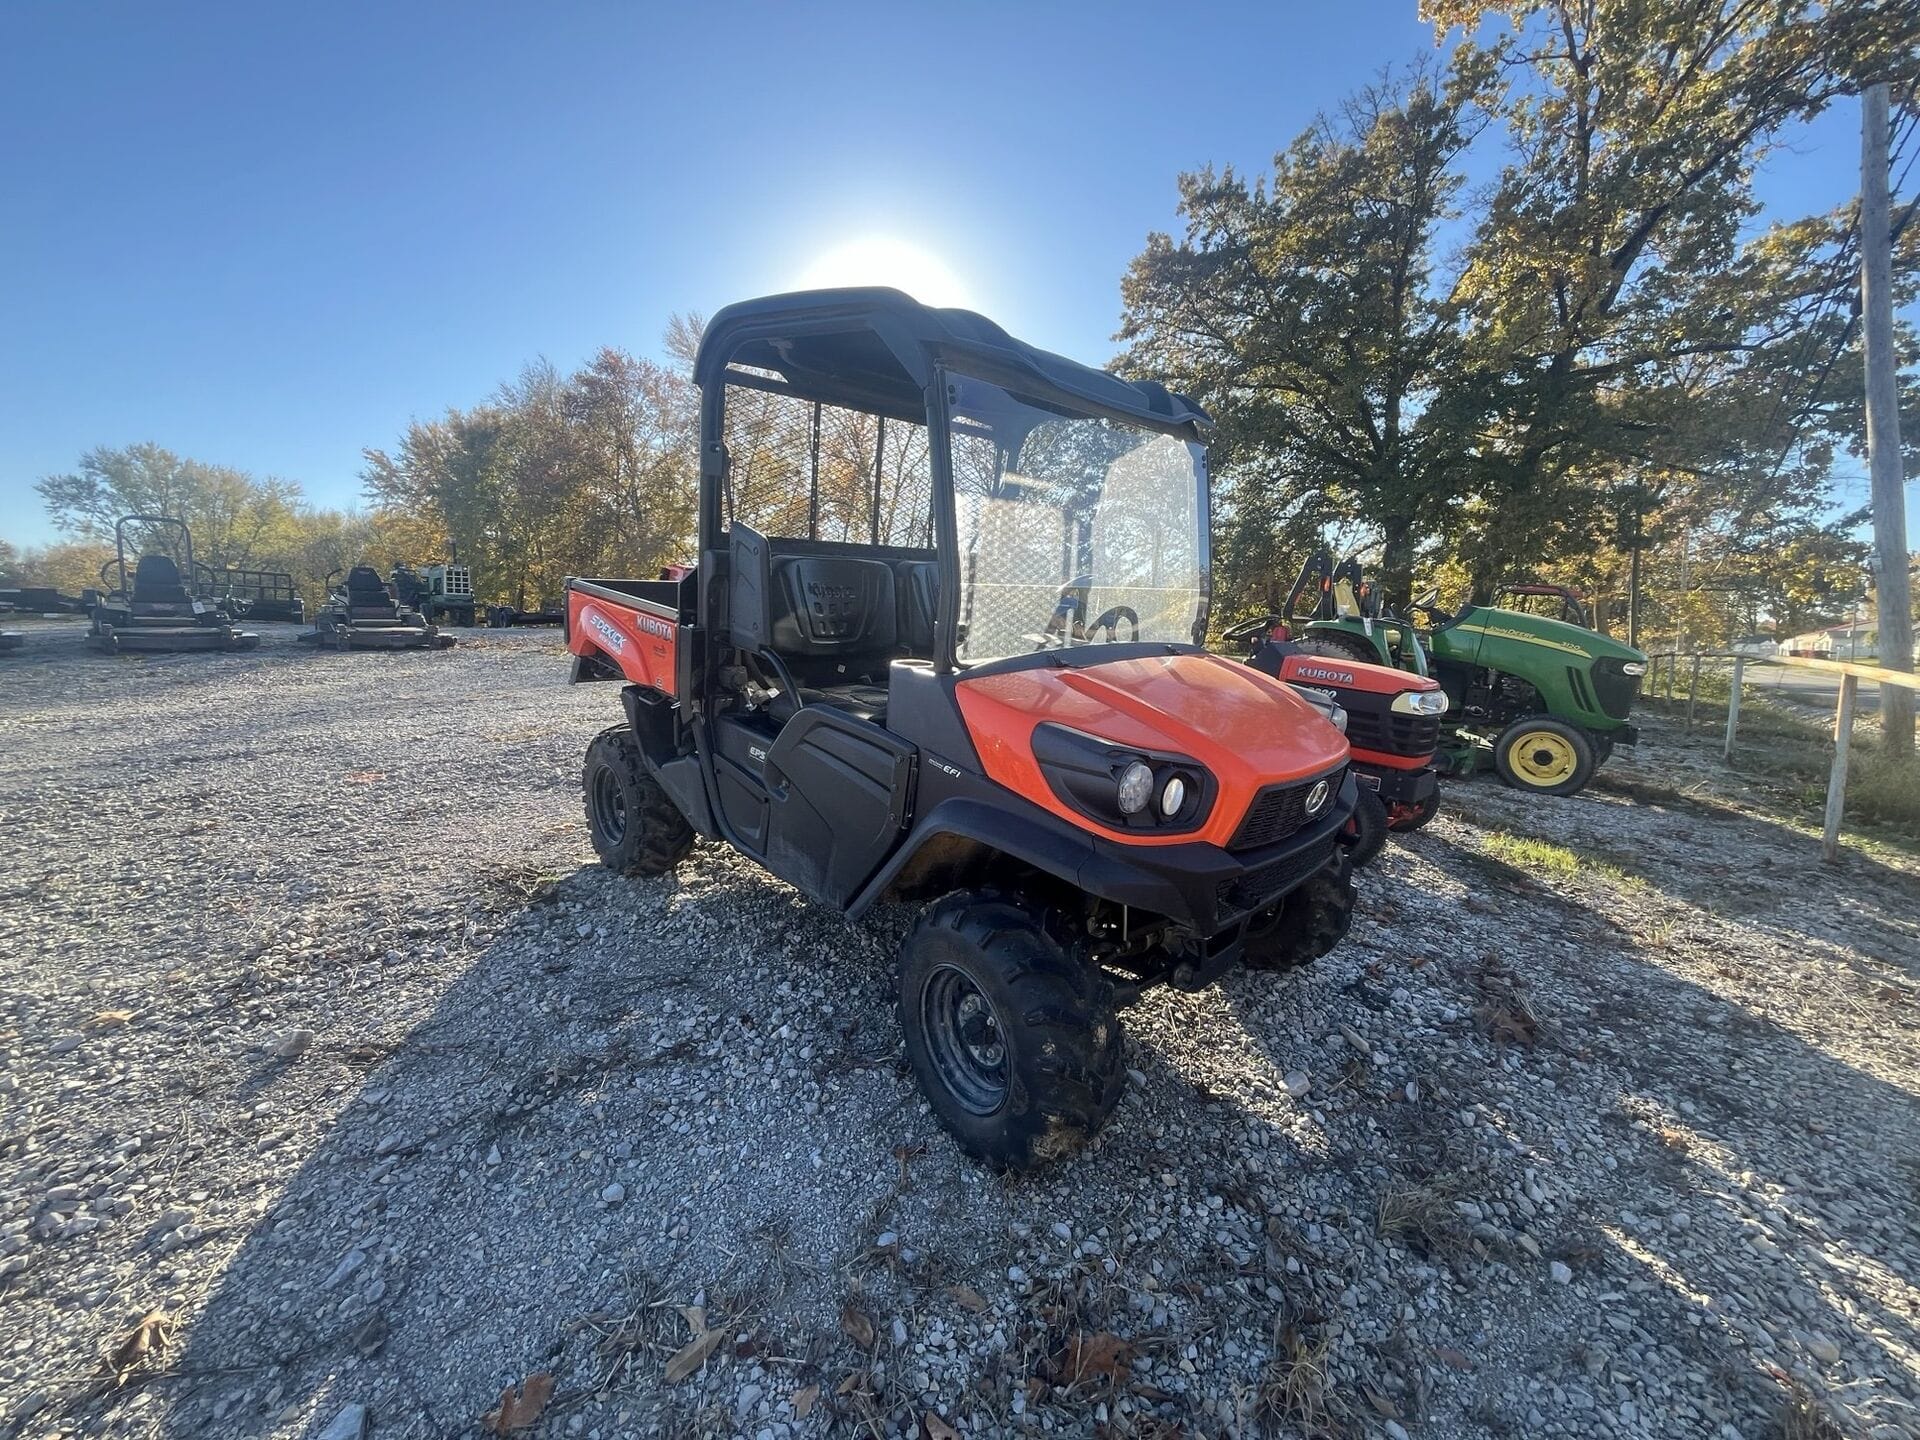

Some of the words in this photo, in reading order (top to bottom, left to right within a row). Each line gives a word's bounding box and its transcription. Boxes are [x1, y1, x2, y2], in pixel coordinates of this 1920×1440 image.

[636, 615, 673, 642] KUBOTA
[1297, 666, 1354, 684] KUBOTA
[749, 746, 767, 760] EPS
[943, 765, 962, 779] EFI
